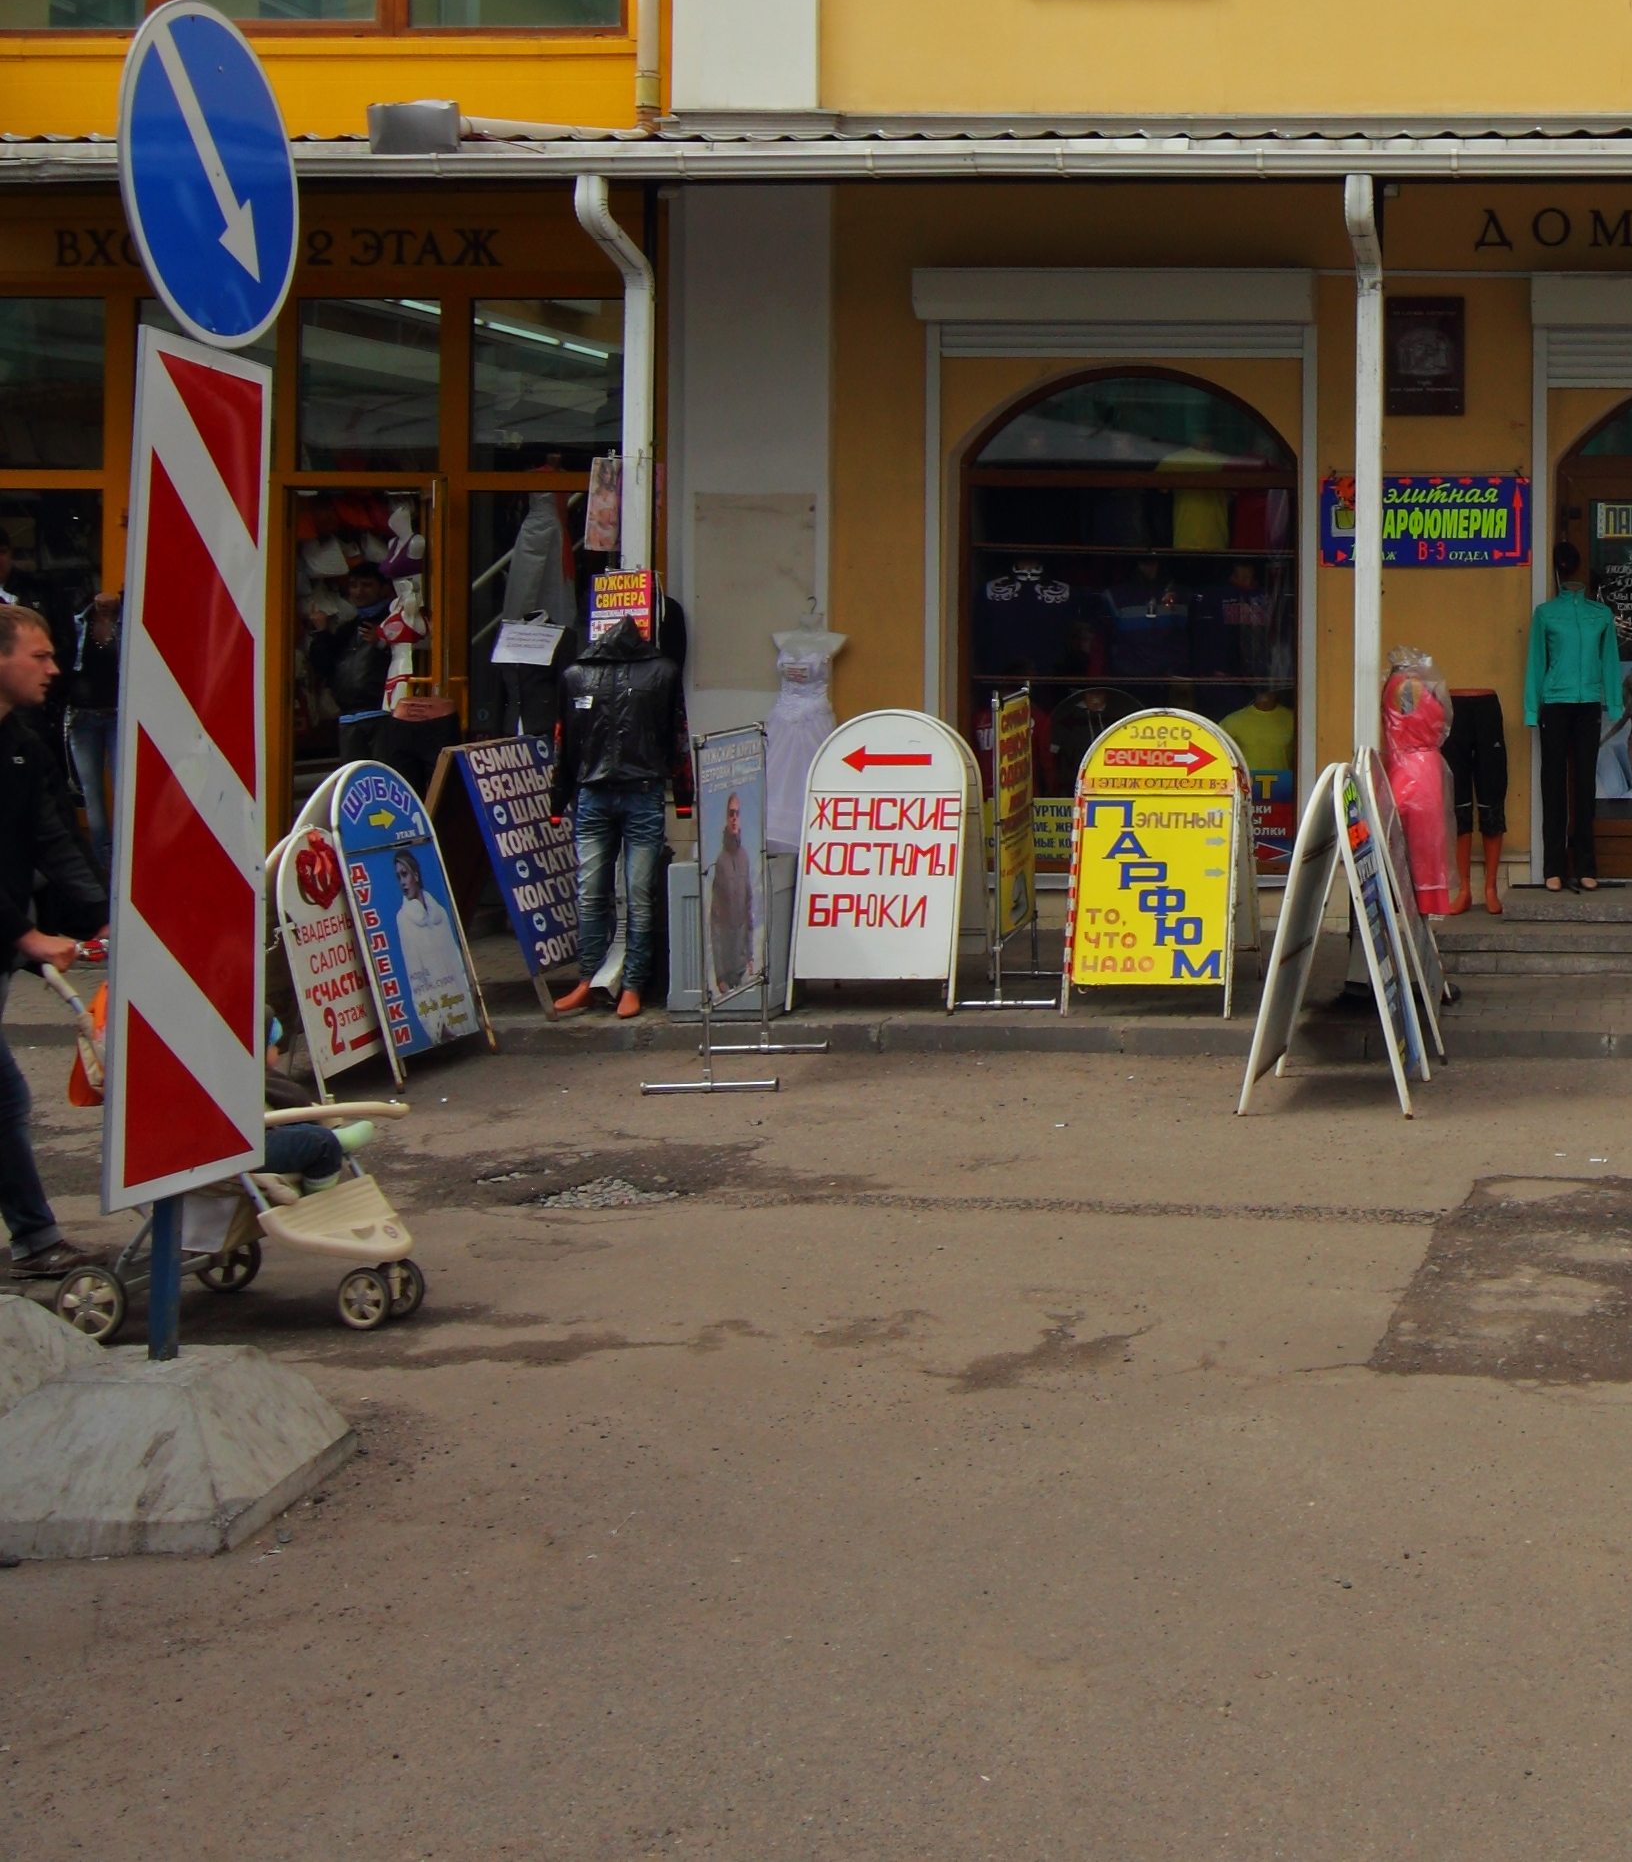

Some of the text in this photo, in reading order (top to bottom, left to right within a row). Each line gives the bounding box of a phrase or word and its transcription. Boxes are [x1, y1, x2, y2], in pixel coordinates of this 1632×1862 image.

[306, 230, 334, 266] 2
[349, 228, 503, 267] ЭТАЖ
[1382, 507, 1508, 540] АРФЮМЕРИЯ
[1448, 549, 1489, 562] ОТДЕЛ
[594, 573, 647, 592] МУЖСКИЕ
[595, 591, 646, 609] СВИТЕРА
[469, 742, 534, 776] СУМКИ
[1098, 778, 1141, 789] ЭТАЖ
[341, 776, 412, 825] ШУБЫ
[809, 796, 961, 831] ЖЕНСКИЕ
[1033, 805, 1072, 818] УРТКИ
[411, 811, 426, 836] 1
[533, 845, 579, 876] ЧАТК
[805, 842, 957, 876] КОСТЮМЫ
[513, 873, 578, 912] КОЛГОТ
[807, 893, 928, 928] БРЮКИ
[348, 862, 413, 1047] ДУБЛЕНКИ
[535, 934, 579, 966] ЗОНТ
[1083, 931, 1138, 949] ЧТО
[309, 941, 357, 975] САЛОН
[1080, 955, 1155, 973] НАДО
[323, 1006, 346, 1057] 2
